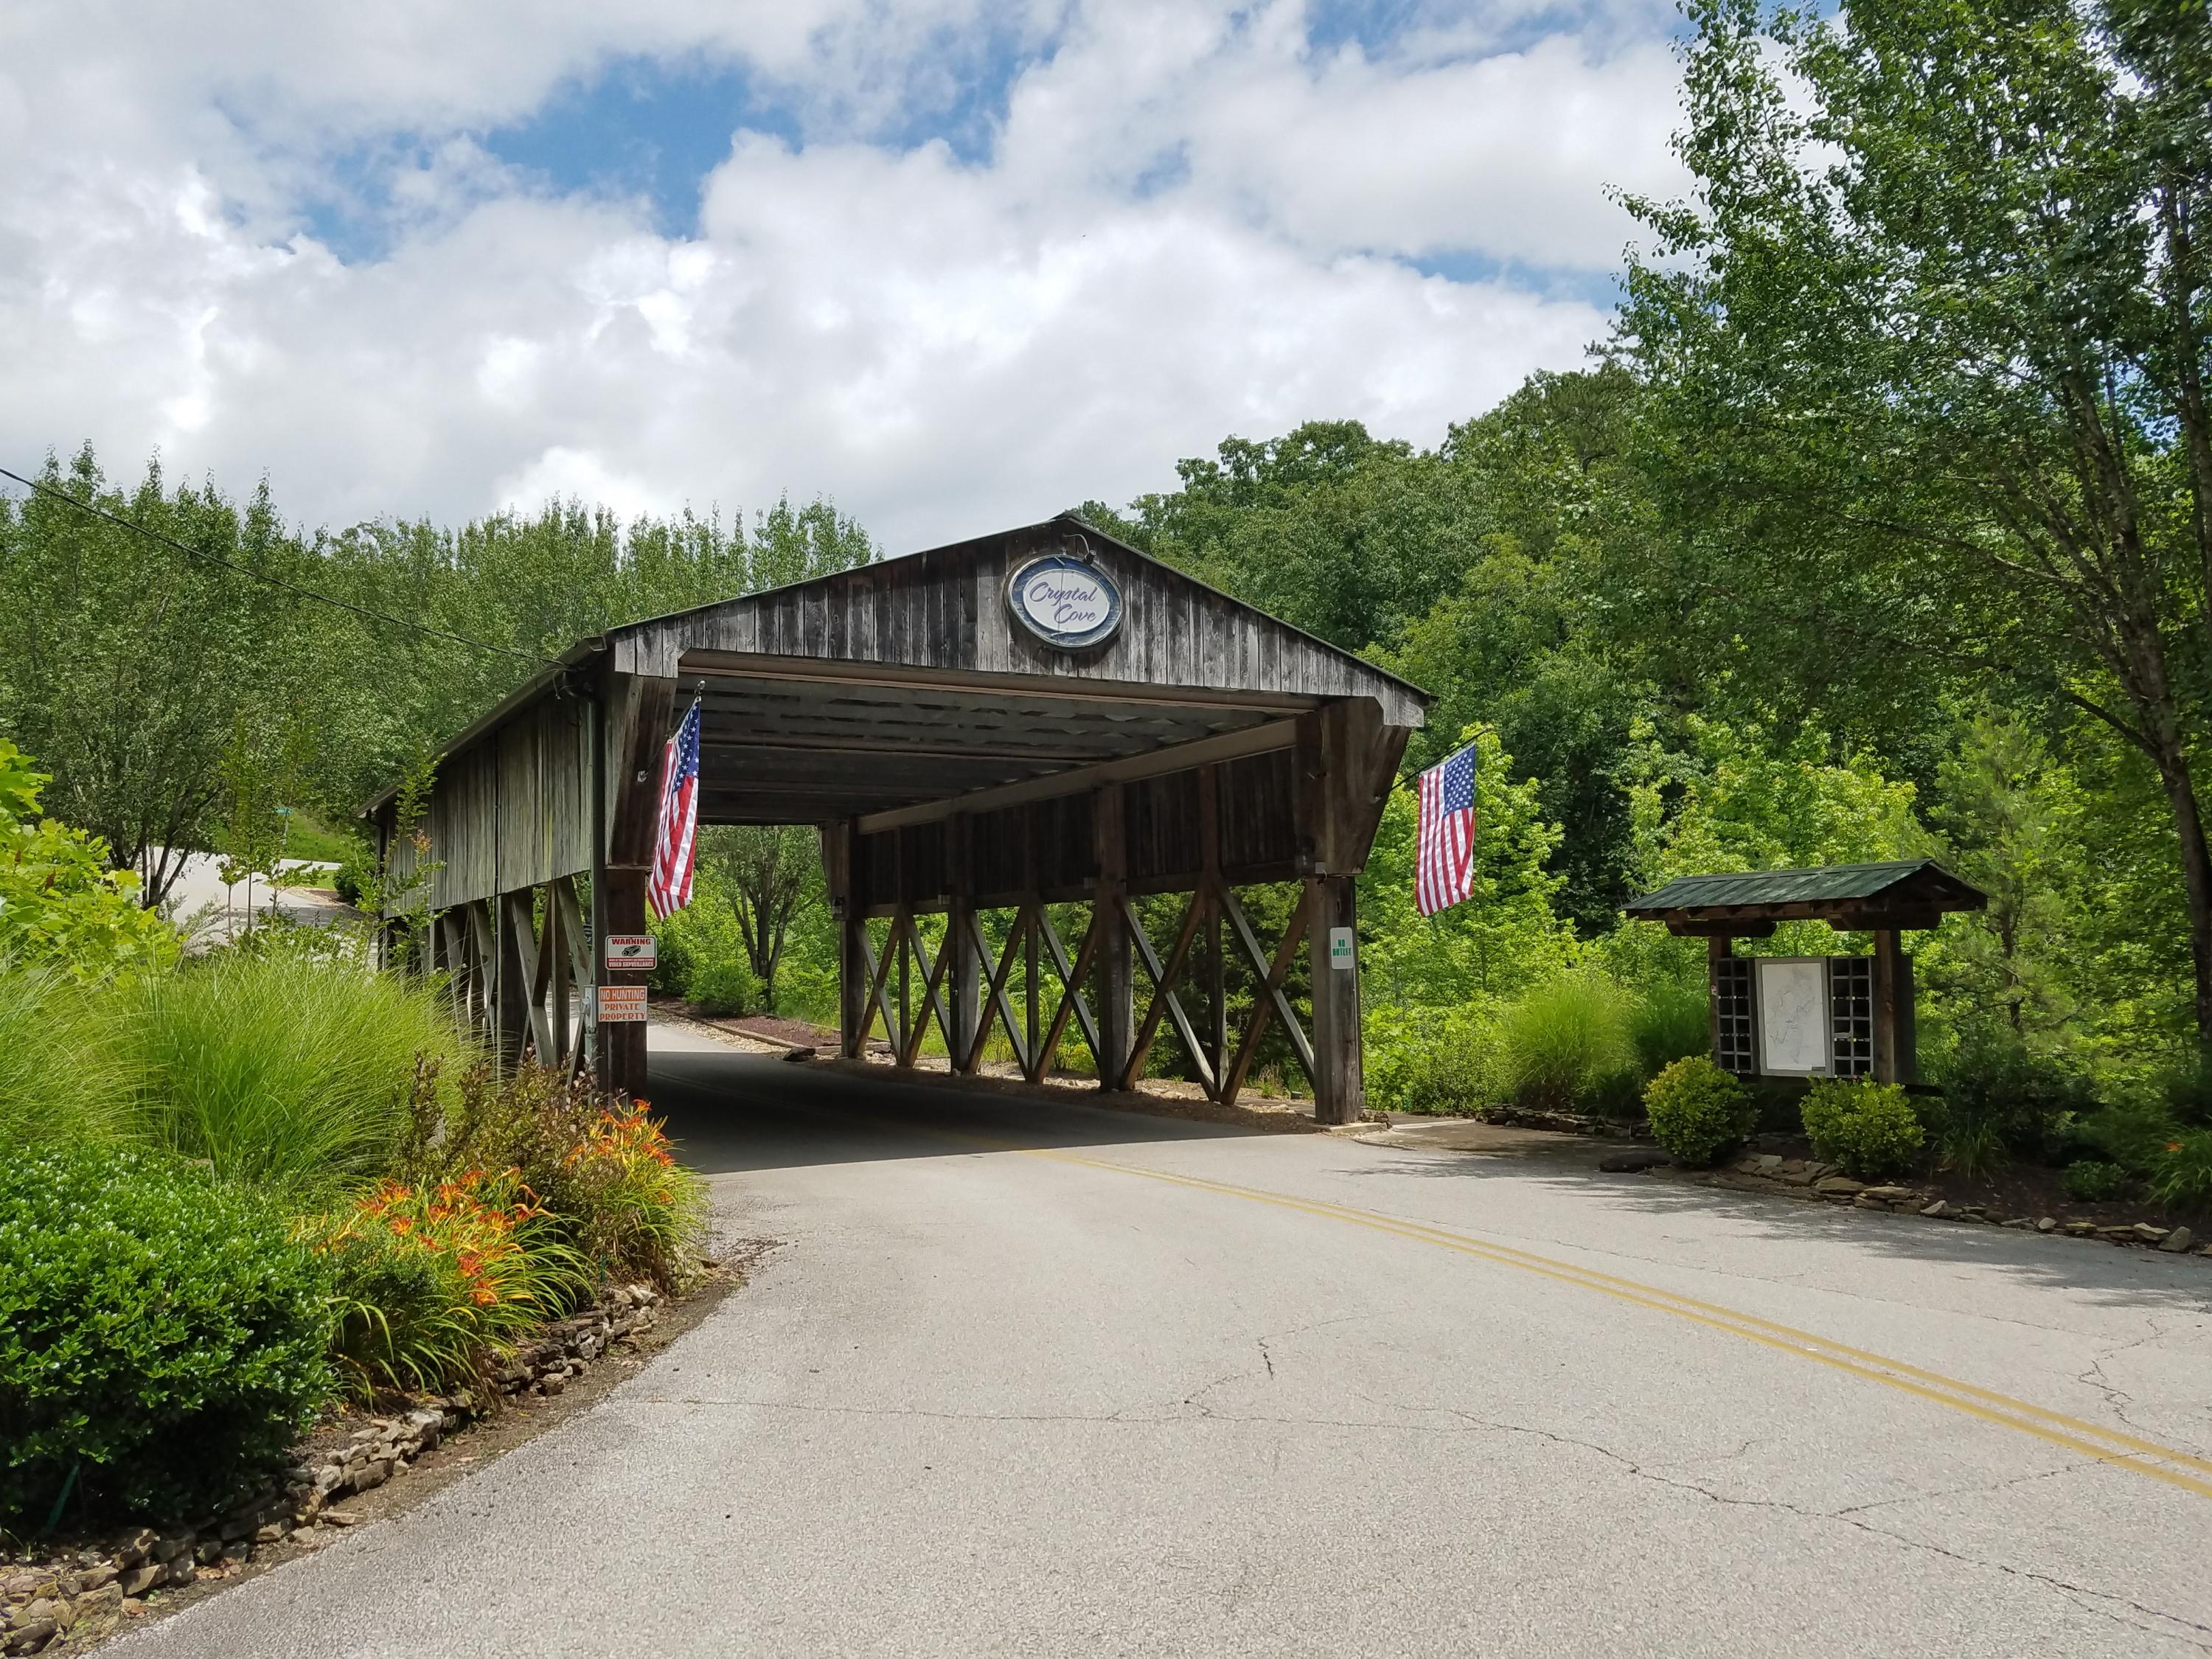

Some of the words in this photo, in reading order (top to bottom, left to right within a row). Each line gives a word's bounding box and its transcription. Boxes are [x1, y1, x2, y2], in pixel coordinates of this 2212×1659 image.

[1029, 581, 1097, 606] Crystal
[1054, 603, 1096, 624] Cove
[1338, 939, 1346, 947] NO
[1332, 947, 1352, 956] OUTLET
[600, 990, 611, 1000] NO
[612, 990, 645, 1000] HUNTING
[604, 1003, 640, 1011] PRIVATE
[599, 1012, 645, 1020] PROPERTY
